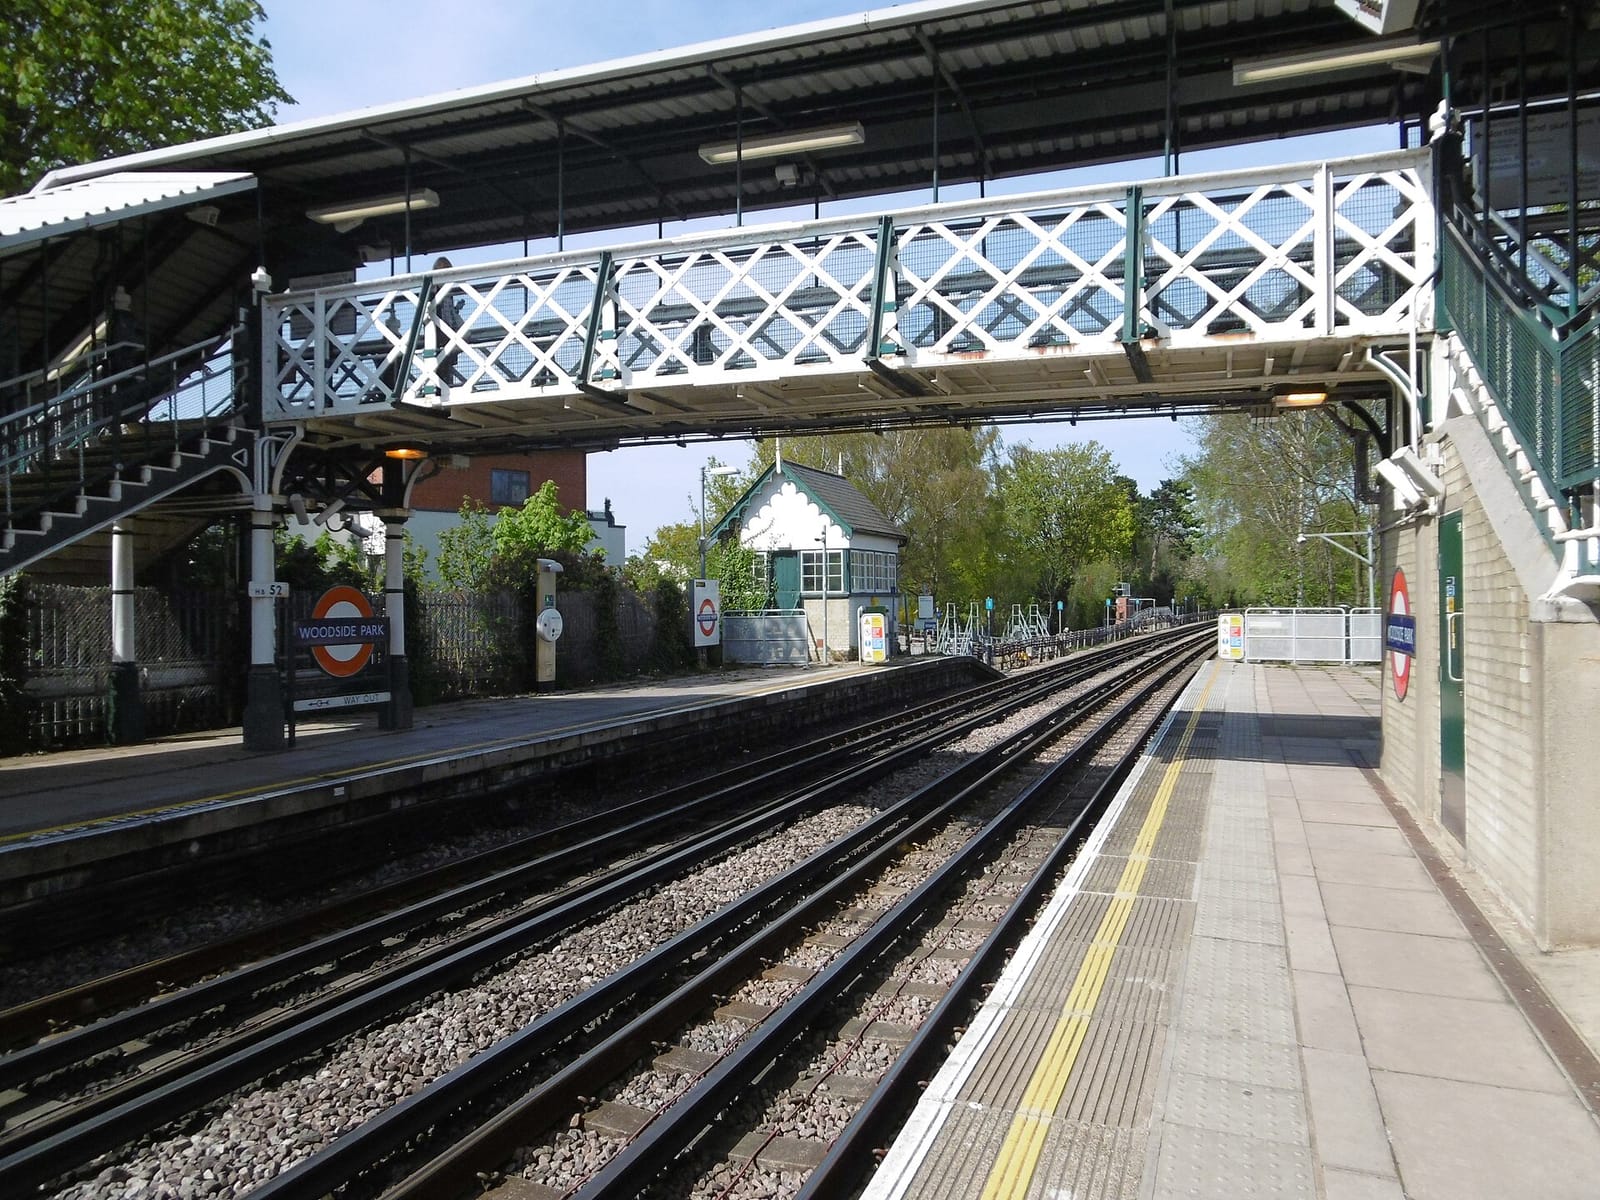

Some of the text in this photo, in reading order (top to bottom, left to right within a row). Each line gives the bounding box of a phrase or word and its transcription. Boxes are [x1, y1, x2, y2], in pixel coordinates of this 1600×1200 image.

[269, 584, 283, 596] 52
[299, 624, 384, 639] WOODSIDE PARK
[343, 693, 380, 705] WAY OUT
